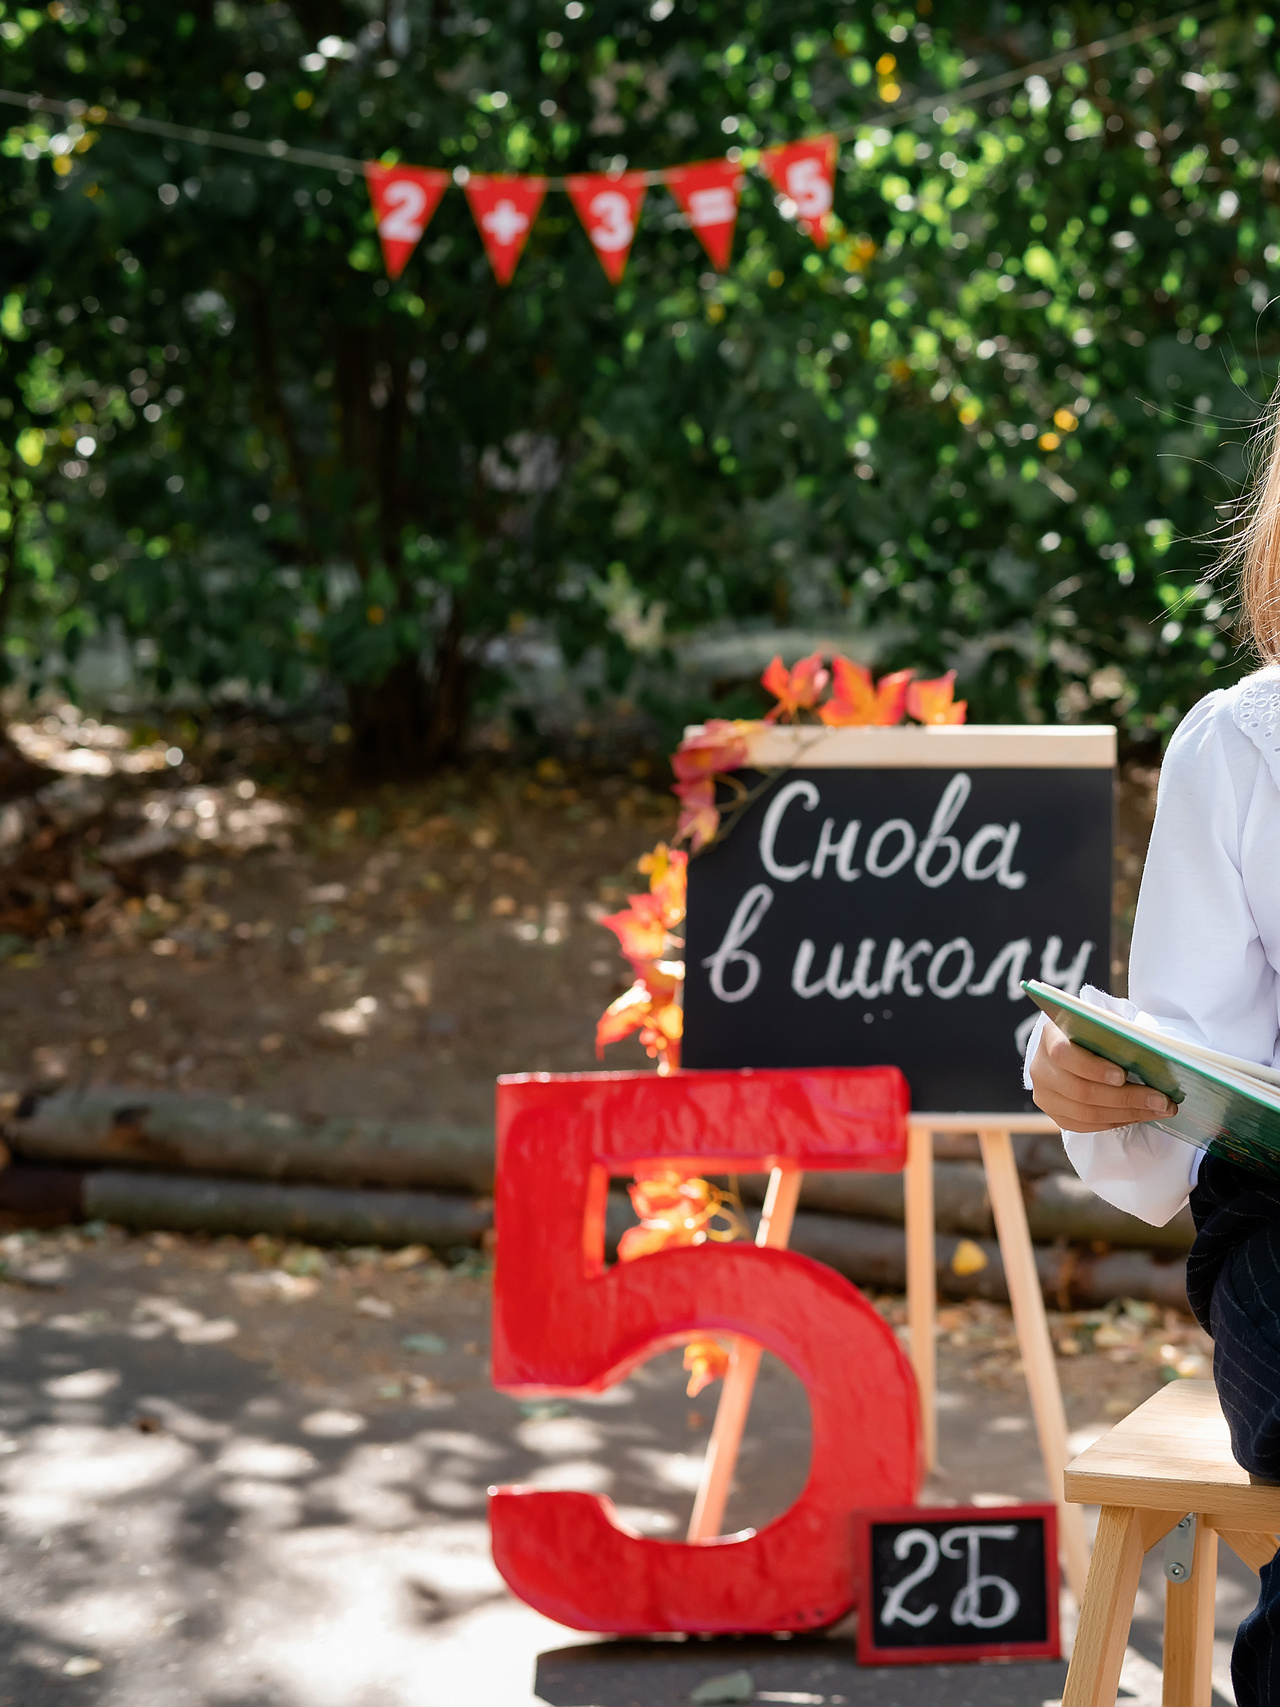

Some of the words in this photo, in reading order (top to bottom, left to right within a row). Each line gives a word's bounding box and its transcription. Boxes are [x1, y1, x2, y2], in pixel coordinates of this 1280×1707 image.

[380, 180, 426, 243] 2
[588, 191, 633, 252] 3
[786, 158, 832, 218] 5
[759, 773, 1026, 889] Снова
[702, 883, 773, 1002] в
[791, 935, 1095, 1056] школу
[488, 1066, 922, 1634] 5
[880, 1525, 1020, 1628] 2Б
